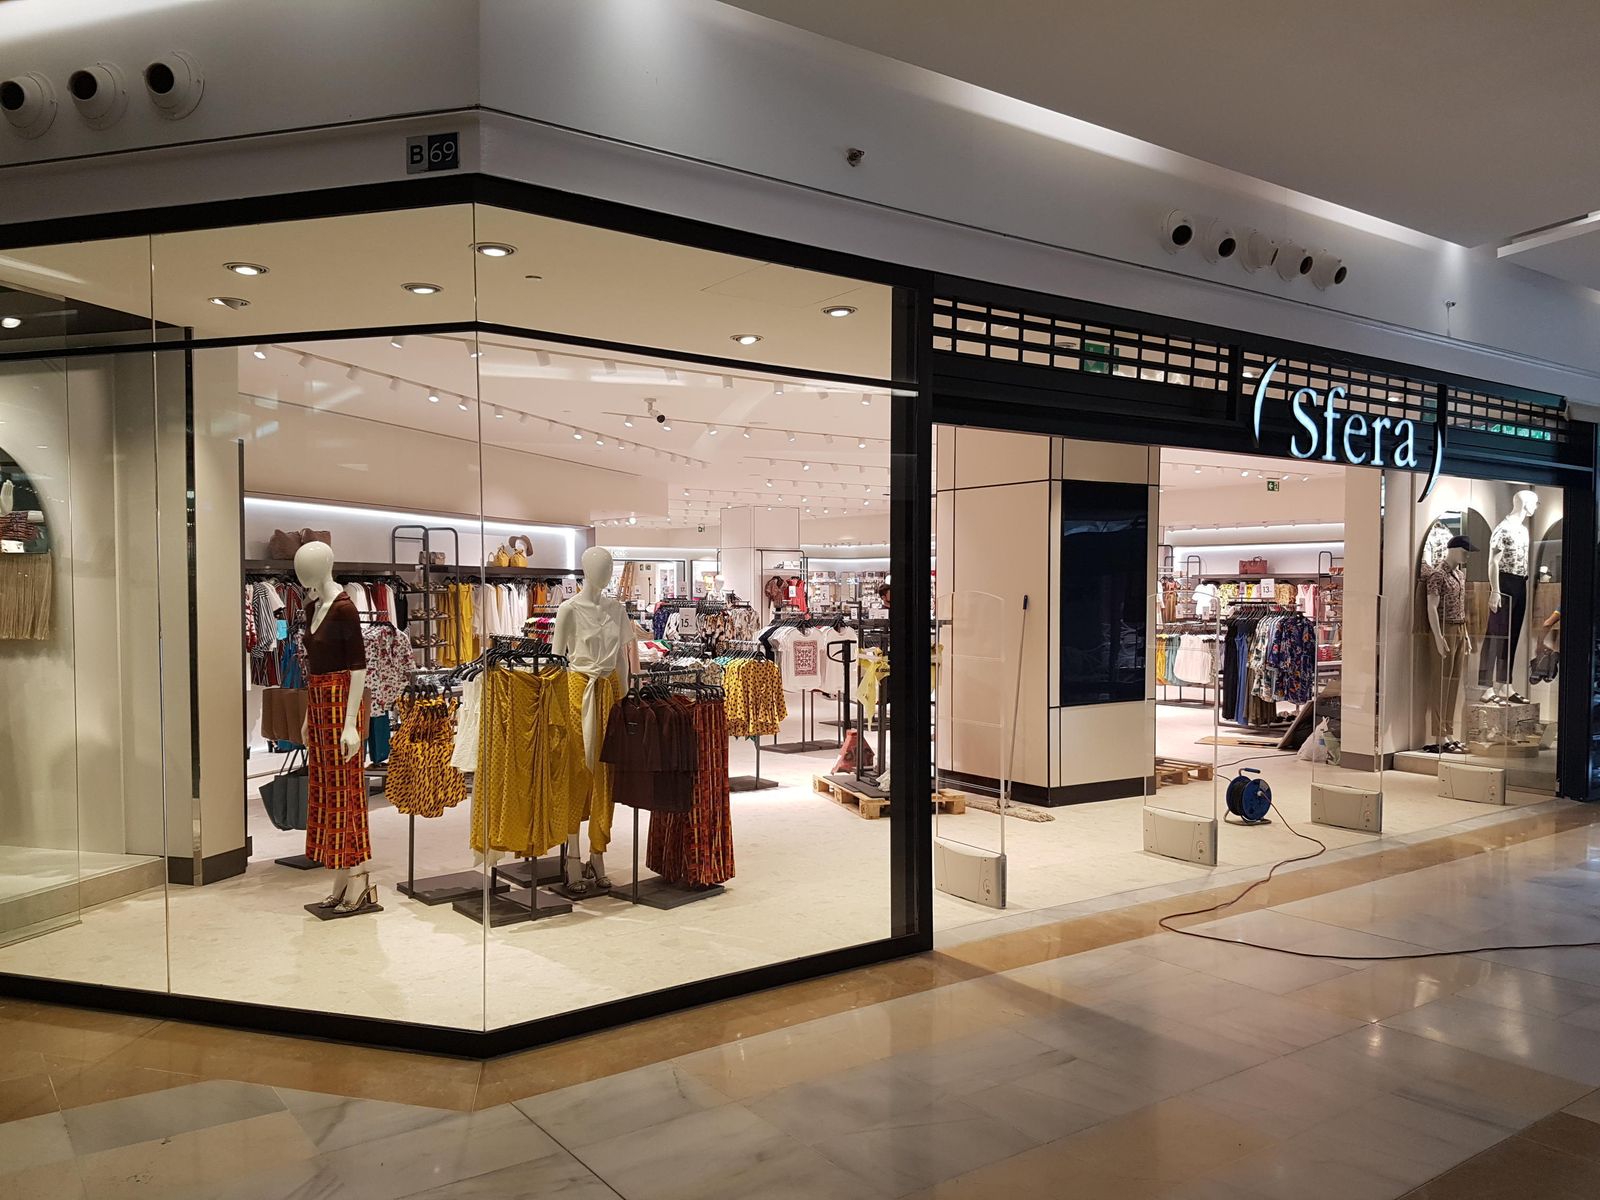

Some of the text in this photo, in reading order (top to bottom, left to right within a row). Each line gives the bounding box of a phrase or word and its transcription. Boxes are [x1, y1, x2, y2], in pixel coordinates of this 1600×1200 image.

[410, 141, 455, 164] B 69
[1290, 386, 1418, 468] Sfera
[681, 618, 689, 627] 15
